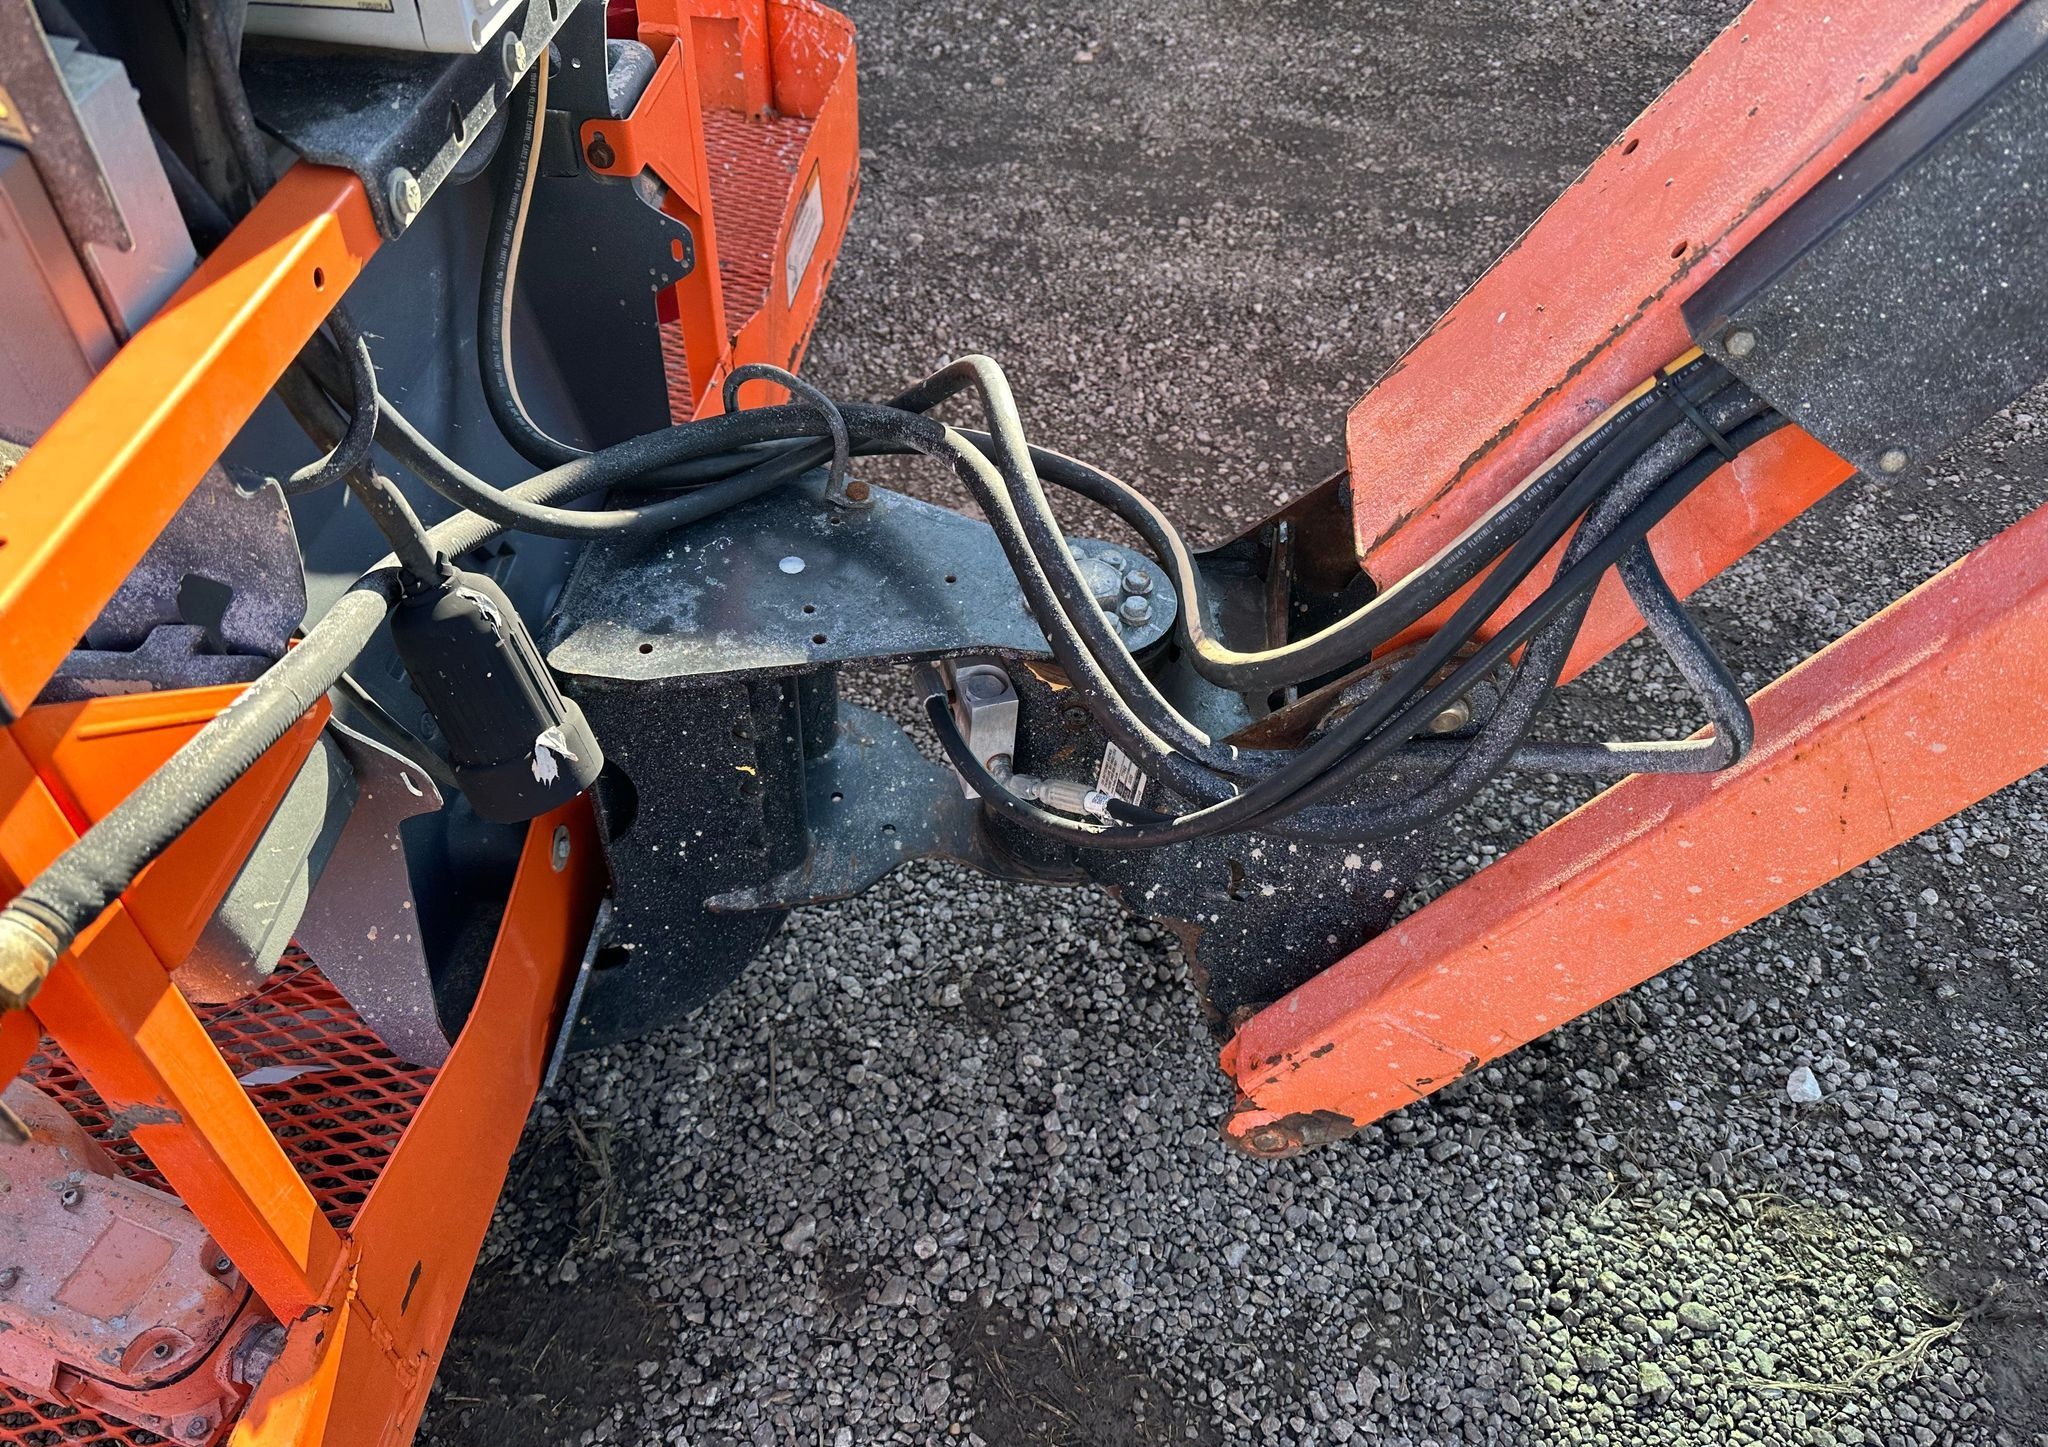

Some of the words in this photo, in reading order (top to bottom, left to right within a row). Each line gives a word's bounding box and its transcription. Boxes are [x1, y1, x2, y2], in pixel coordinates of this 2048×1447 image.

[520, 145, 529, 159] CABLE
[1467, 523, 1494, 548] FLEXIBLE
[1495, 500, 1522, 526] CONTROL
[1523, 483, 1542, 502] CABLE
[1582, 422, 1614, 451] FEBRUARY
[1634, 394, 1654, 412] AWM
